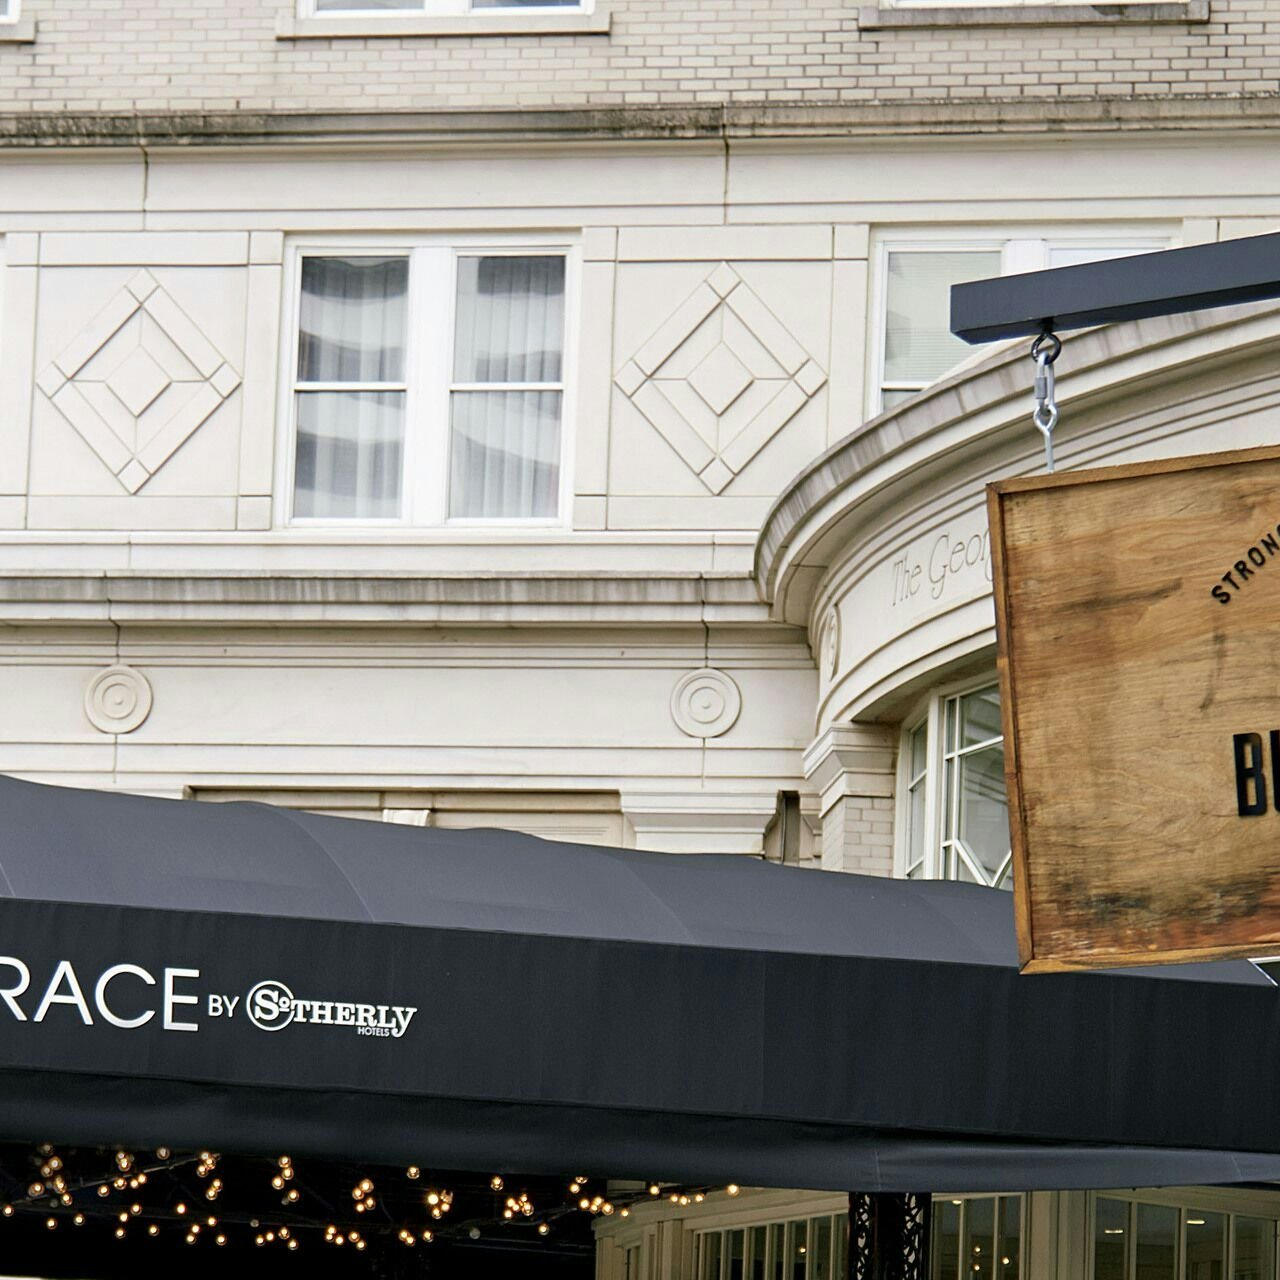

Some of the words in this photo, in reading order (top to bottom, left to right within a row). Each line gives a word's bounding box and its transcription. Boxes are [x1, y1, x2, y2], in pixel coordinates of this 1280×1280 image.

[892, 551, 923, 607] The
[207, 993, 240, 1018] BY
[357, 1026, 391, 1037] HOTELS
